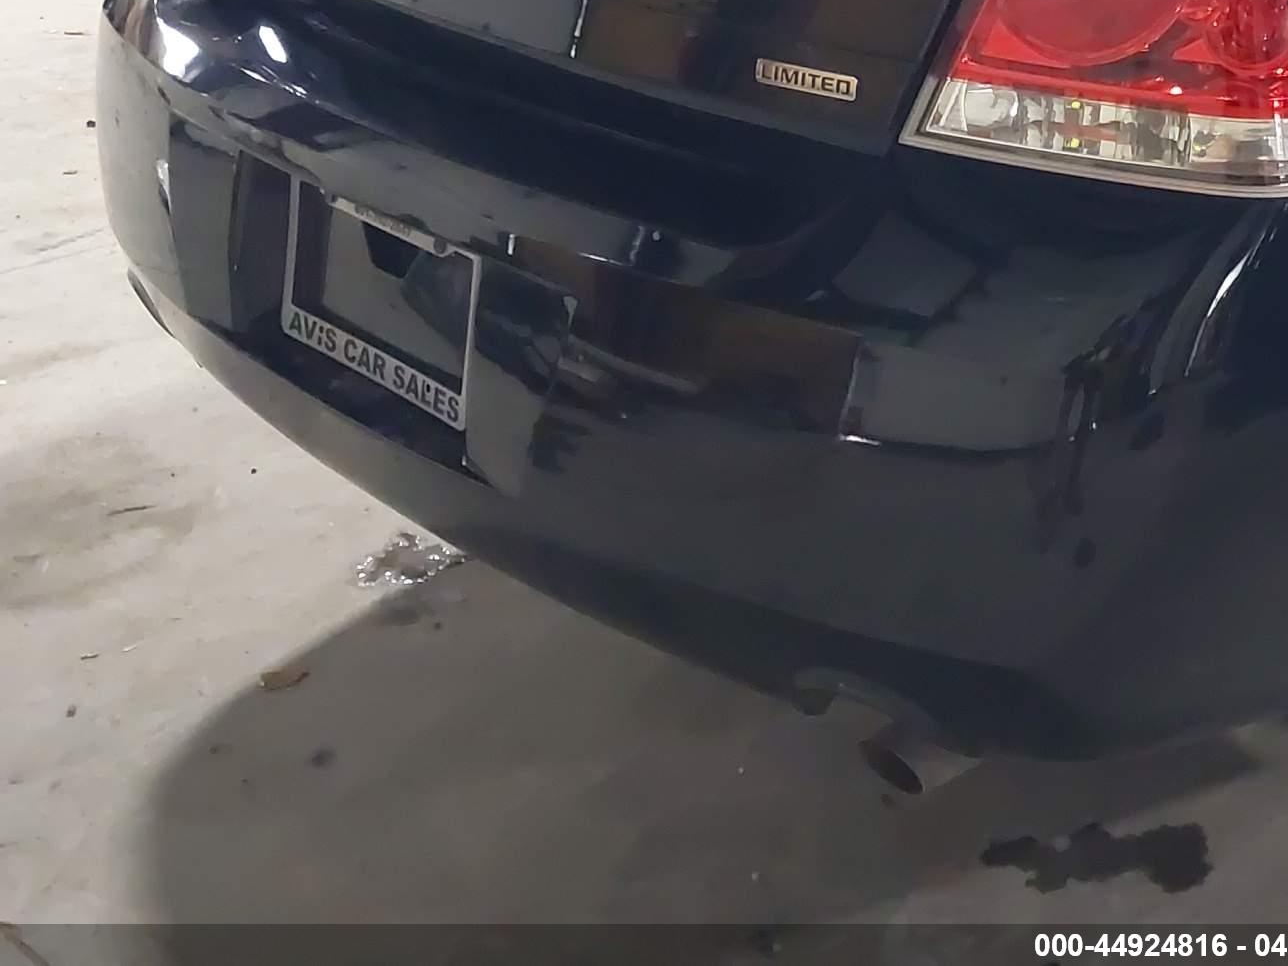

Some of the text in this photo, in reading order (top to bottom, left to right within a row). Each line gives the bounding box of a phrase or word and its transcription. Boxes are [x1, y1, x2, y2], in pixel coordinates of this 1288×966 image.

[761, 64, 852, 95] LIMITED
[288, 311, 460, 423] AVIS CAR SALES
